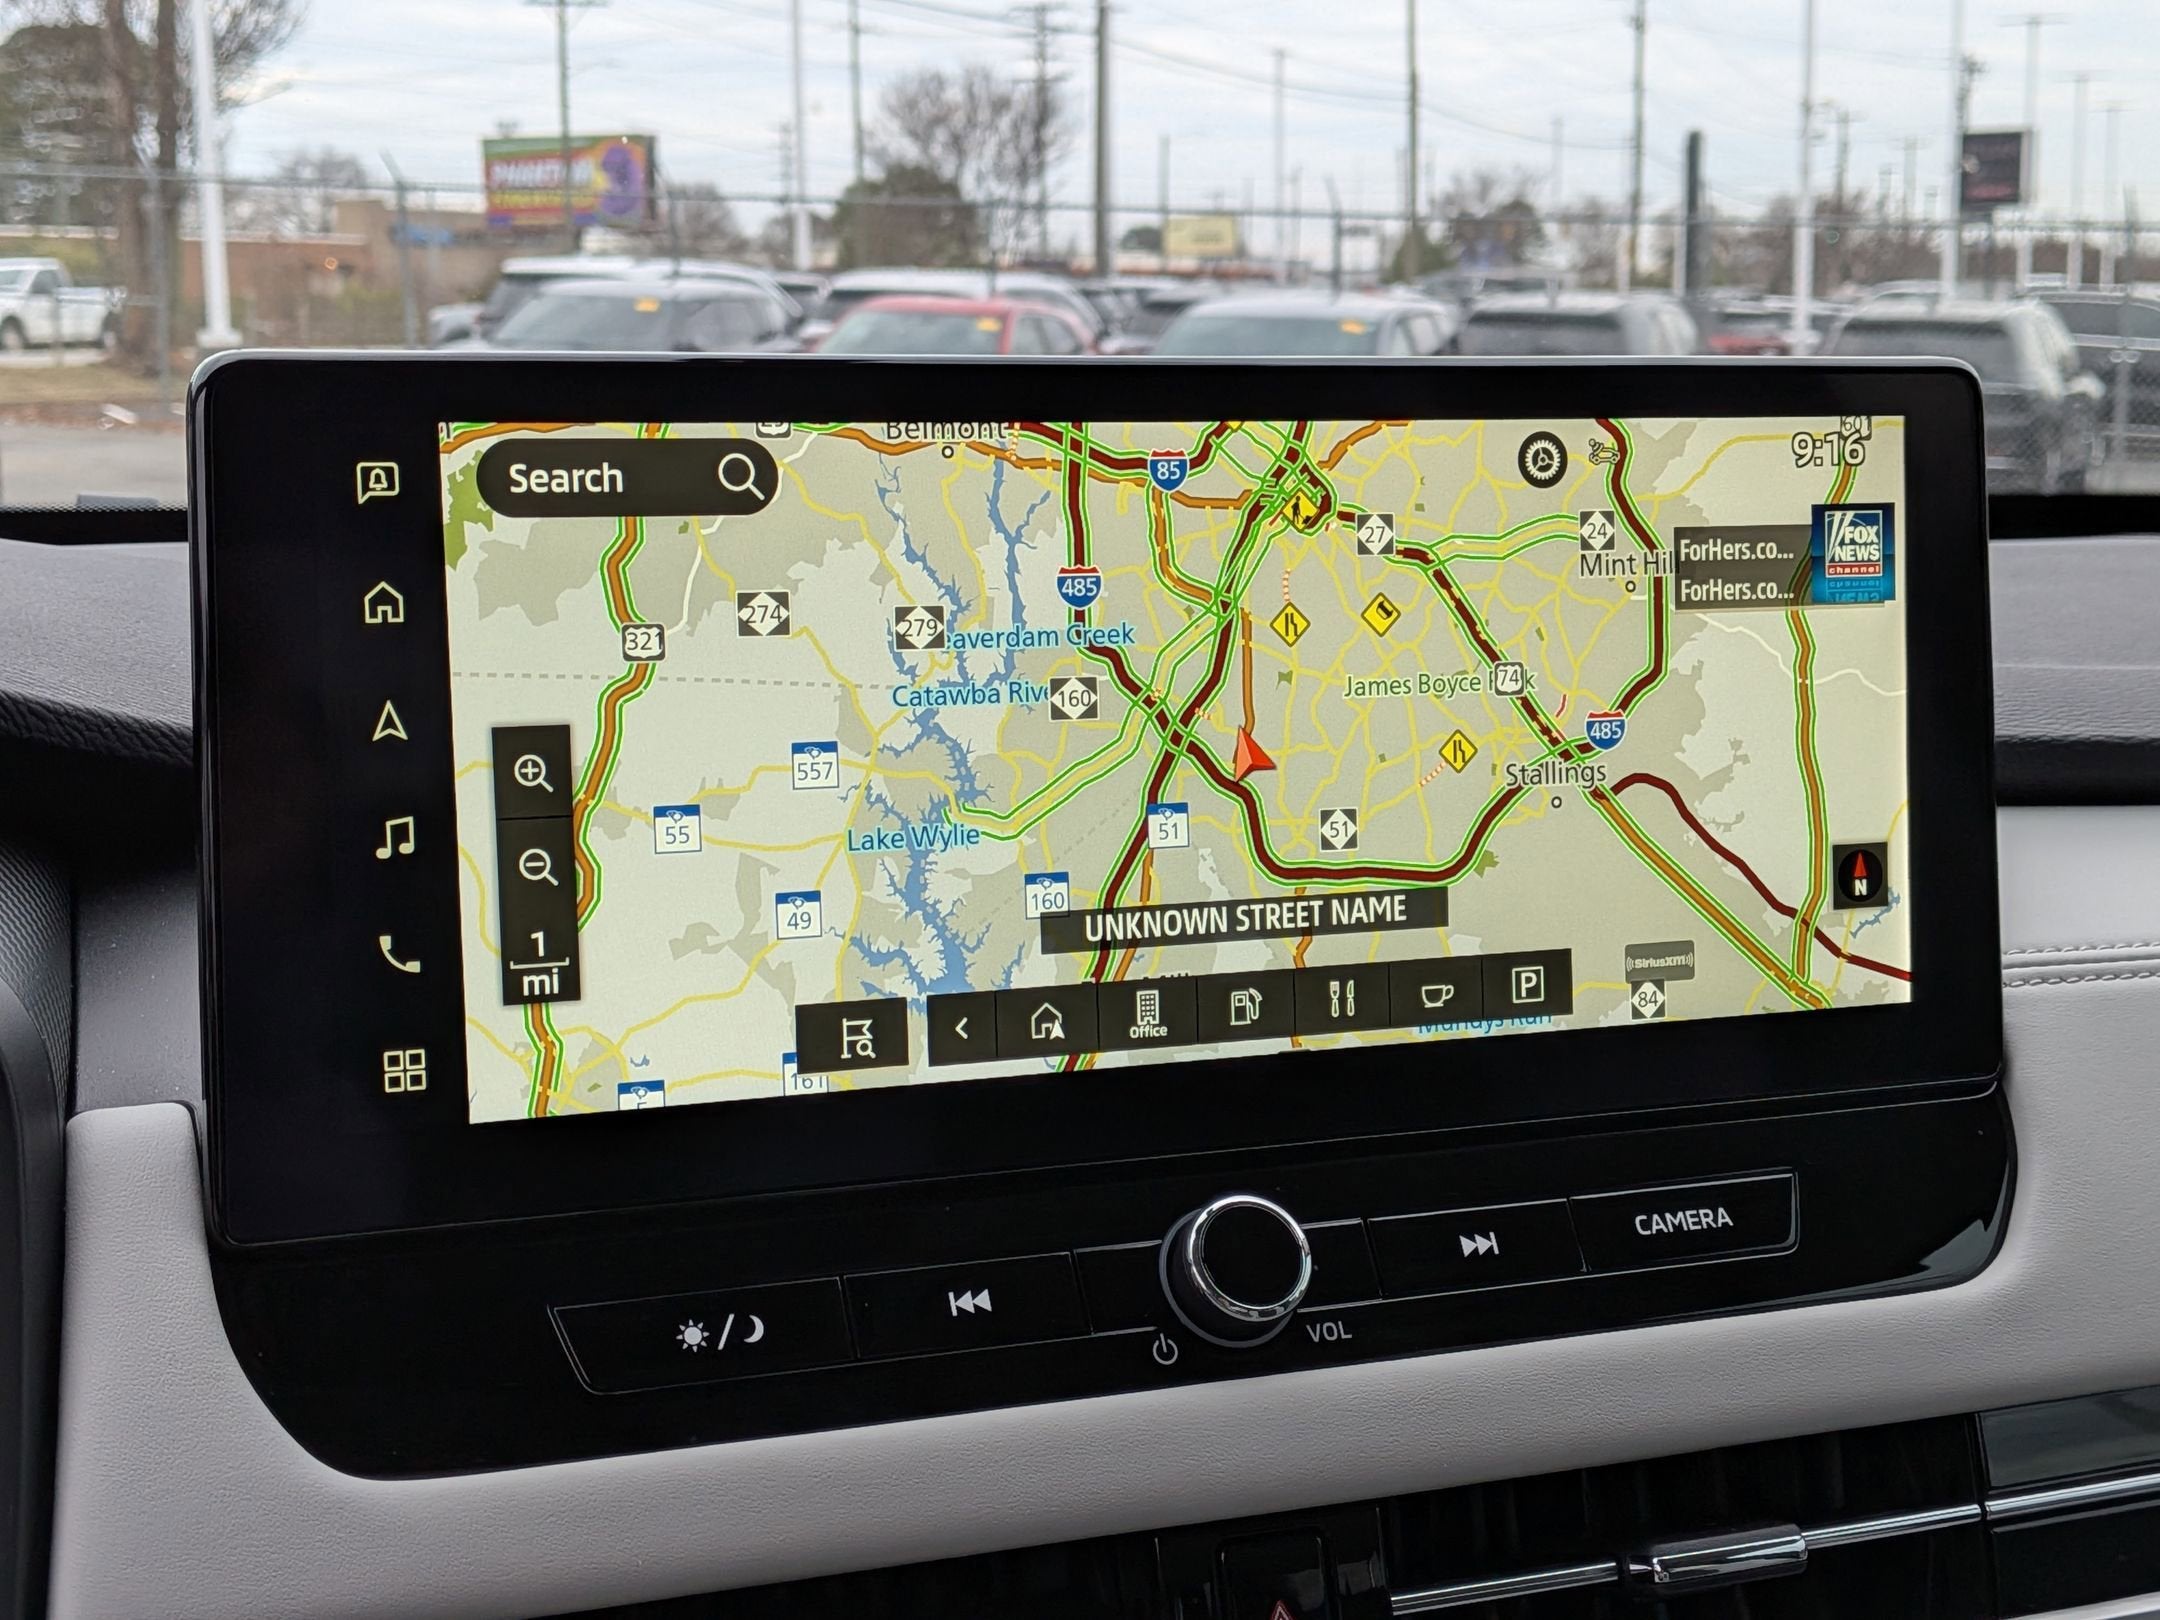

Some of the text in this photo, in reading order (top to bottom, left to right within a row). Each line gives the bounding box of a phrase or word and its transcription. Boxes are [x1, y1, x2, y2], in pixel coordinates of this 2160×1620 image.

[887, 422, 1009, 440] Belmont
[1843, 416, 1870, 431] 601
[1792, 431, 1865, 468] 9:16
[509, 462, 624, 493] Search
[1156, 461, 1181, 480] 85
[1364, 526, 1385, 544] 27
[1587, 523, 1607, 539] 24
[1844, 525, 1878, 544] FOX
[1679, 538, 1794, 562] ForHers.co...
[1833, 545, 1880, 562] NEWS
[1580, 553, 1637, 577] Mint
[1828, 565, 1880, 574] channel
[1061, 577, 1097, 597] 485
[1680, 579, 1794, 602] ForHers.co...
[745, 605, 783, 624] 274
[902, 619, 938, 637] 279
[1066, 622, 1135, 645] Creek
[626, 632, 662, 652] 321
[1344, 676, 1411, 697] James
[1419, 674, 1481, 698] Boyce
[1499, 670, 1519, 686] 74
[892, 682, 1000, 707] Catawba
[1058, 689, 1091, 708] 160
[1590, 721, 1622, 740] 485
[797, 762, 833, 781] 557
[1506, 761, 1606, 789] Stallings
[665, 827, 689, 844] 55
[848, 825, 980, 852] Lake Wylie
[1158, 823, 1179, 841] 51
[1329, 820, 1350, 838] 51
[1854, 879, 1867, 896] N
[1031, 892, 1064, 911] 160
[787, 912, 811, 930] 49
[1085, 895, 1407, 942] UNKNOWN STREET NAME
[531, 931, 545, 957] 1
[523, 967, 559, 997] mi
[1638, 991, 1659, 1008] 84
[1129, 1024, 1168, 1039] Office
[1635, 1207, 1733, 1236] CAMERA
[1306, 1320, 1352, 1342] VOL
